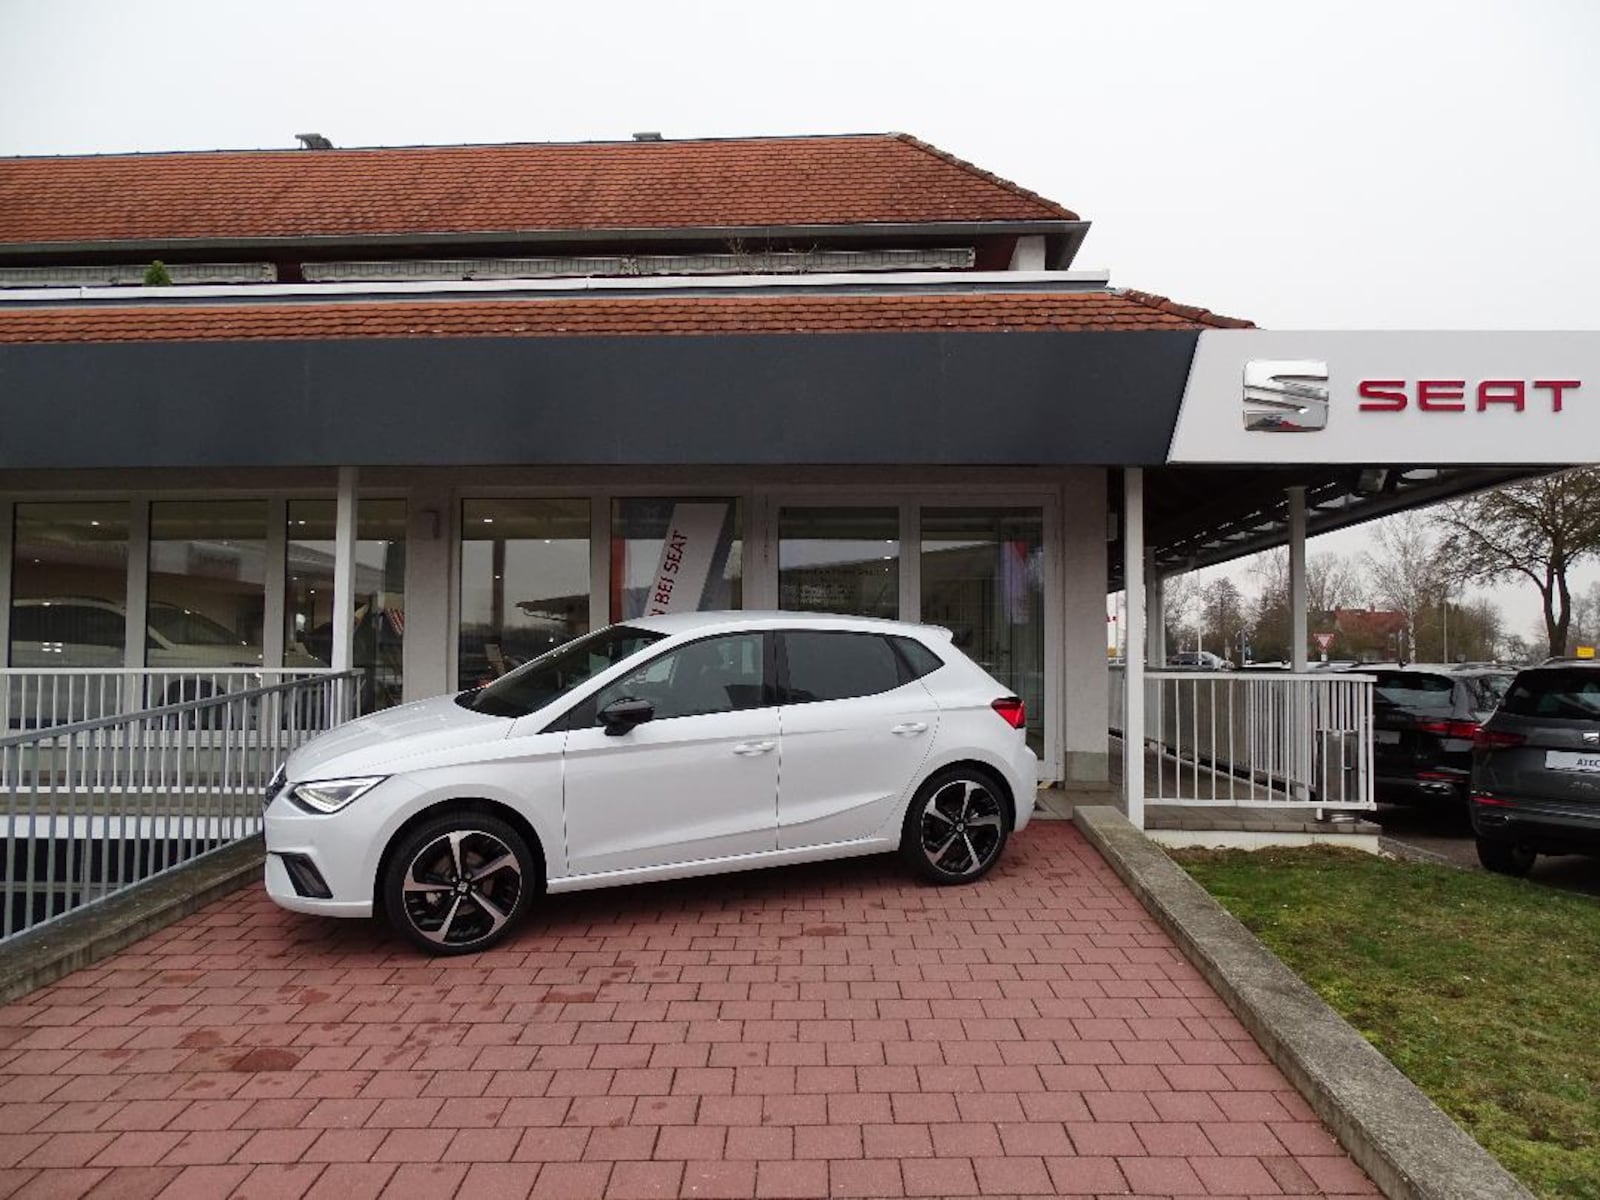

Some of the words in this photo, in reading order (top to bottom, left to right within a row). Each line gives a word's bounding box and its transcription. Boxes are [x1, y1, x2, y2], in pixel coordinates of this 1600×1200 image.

[1357, 380, 1582, 412] SEAT
[664, 530, 687, 574] SEAT
[654, 576, 675, 605] BEI
